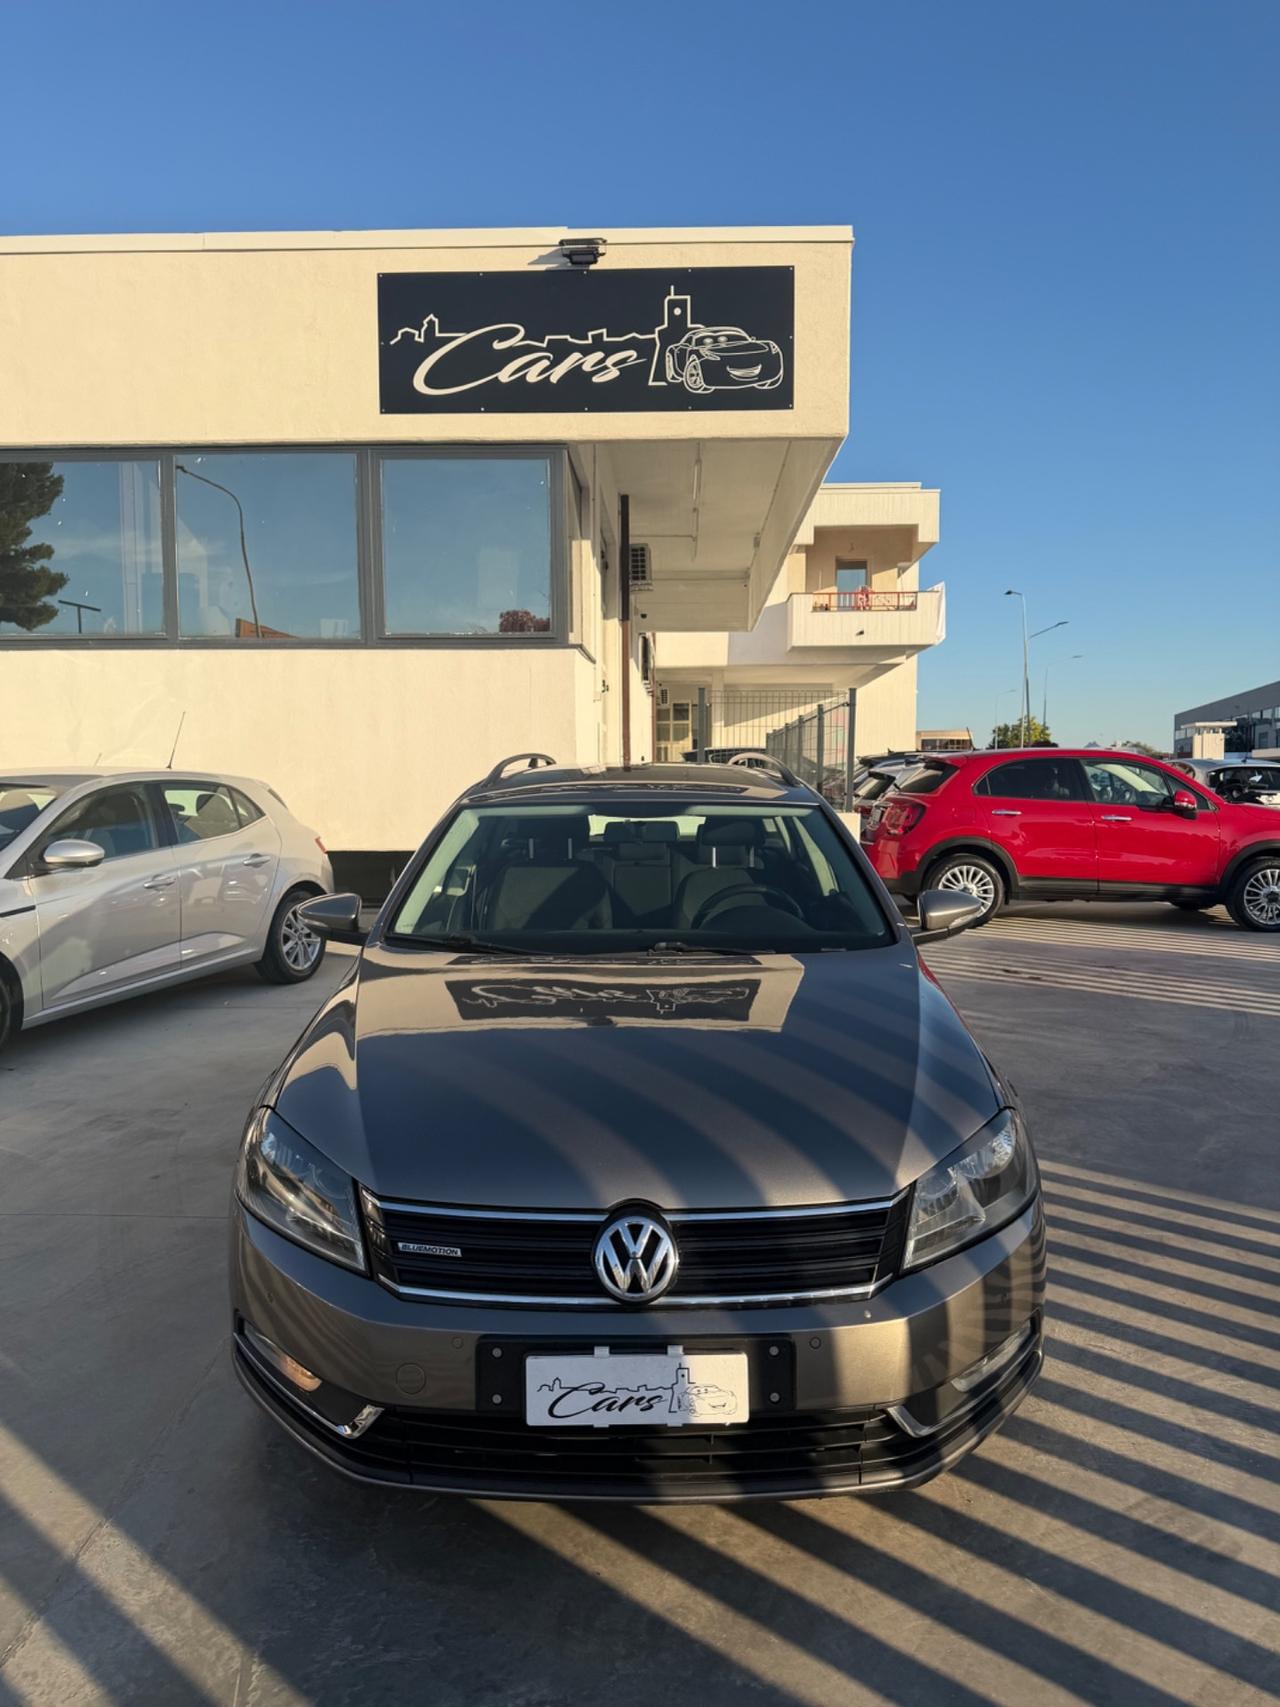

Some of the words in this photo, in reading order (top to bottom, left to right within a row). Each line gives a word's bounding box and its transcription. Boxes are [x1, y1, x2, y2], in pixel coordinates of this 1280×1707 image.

[413, 323, 647, 396] Cars
[401, 1243, 460, 1256] BLUEMOTION
[597, 1220, 677, 1300] VW
[548, 1382, 666, 1418] Cars
